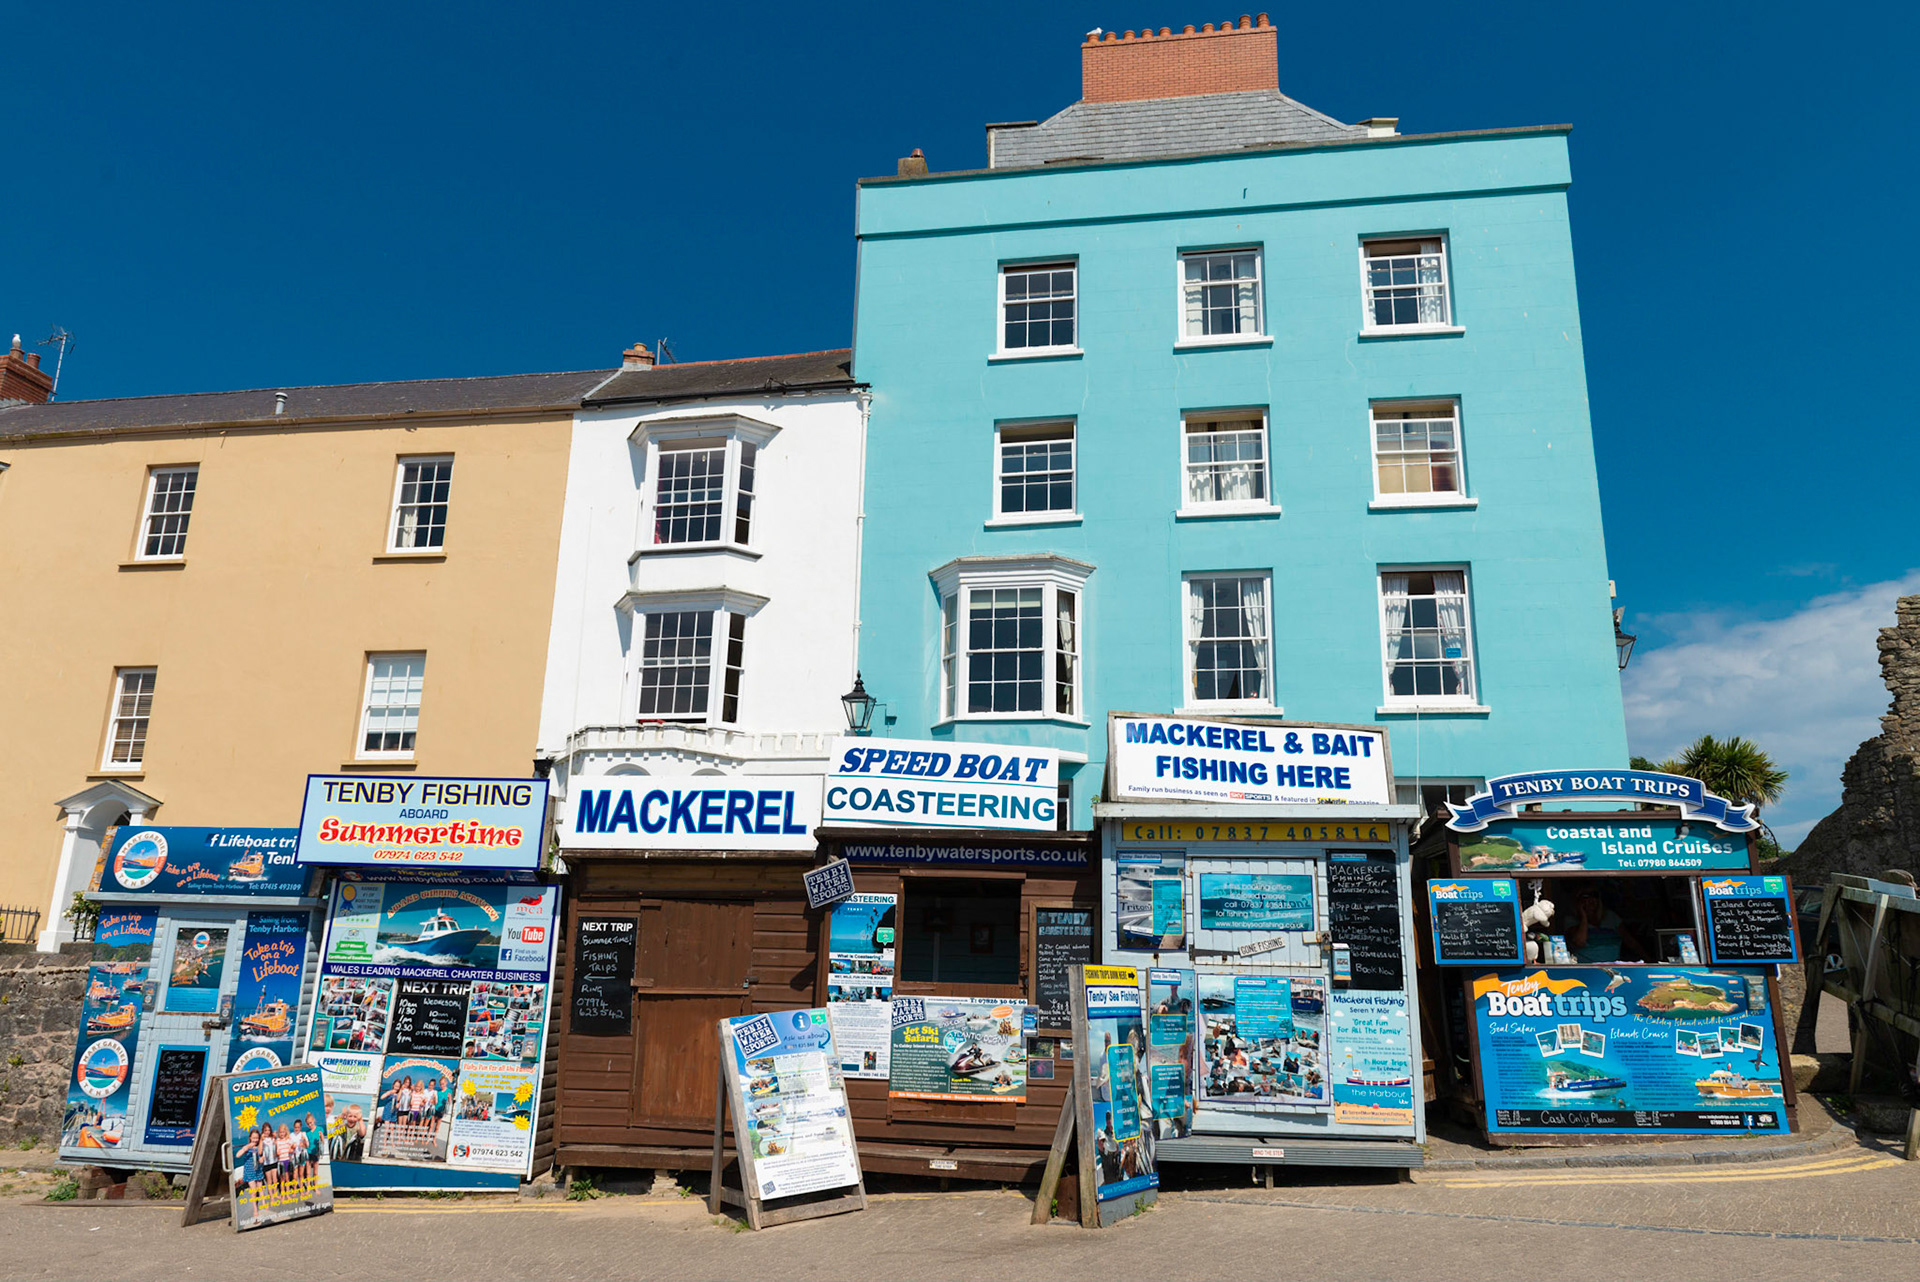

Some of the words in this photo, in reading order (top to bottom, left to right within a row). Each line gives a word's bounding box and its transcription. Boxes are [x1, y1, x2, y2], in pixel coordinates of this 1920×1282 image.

[1126, 722, 1275, 753] MACKEREL
[1283, 732, 1304, 755] &
[1311, 733, 1375, 758] BAIT
[839, 747, 952, 777] SPEED
[953, 753, 1049, 782] BOAT
[1155, 755, 1268, 785] FISHING
[1276, 764, 1351, 790] HERE
[322, 781, 416, 804] TENBY
[421, 783, 532, 806] FISHING
[1499, 777, 1564, 797] TENBY
[1570, 776, 1626, 791] BOAT
[1630, 777, 1690, 797] TRIPS
[1128, 785, 1150, 793] Family
[1164, 787, 1193, 795] business
[1280, 795, 1309, 804] featured
[826, 786, 1056, 822] COASTEERING
[399, 808, 448, 820] ABOARD
[575, 789, 808, 835] MACKEREL
[319, 818, 522, 847] Summertime
[1134, 825, 1182, 840] Call:
[1195, 826, 1268, 840] 07837
[1286, 826, 1378, 841] 405816
[1546, 825, 1615, 839] Coastal
[1619, 825, 1652, 839] and
[121, 834, 144, 855] MARY
[144, 833, 166, 856] GABRIEL
[219, 834, 275, 848] Lifeboat
[1601, 840, 1658, 855] Island
[1662, 840, 1733, 854] Cruises
[374, 850, 411, 861] 07974
[414, 851, 436, 861] 623
[439, 852, 463, 862] 542
[845, 843, 1088, 863] www.tenbywatersports.co.uk
[164, 862, 180, 876] Take
[187, 862, 201, 873] trip
[1328, 865, 1391, 876] MACKEREL
[1617, 858, 1636, 868] Tel:
[1637, 858, 1667, 868] 07980
[1668, 858, 1703, 868] 864509
[117, 872, 155, 888] TENBY
[176, 877, 186, 888] on
[192, 870, 221, 882] Lifeboat
[367, 874, 506, 885] www.tenbyfishing.co.uk
[807, 864, 846, 886] TENBY
[1332, 874, 1374, 882] FISHING
[259, 883, 278, 891] 07415
[278, 883, 302, 891] 493109
[810, 874, 849, 895] WATER
[1708, 886, 1734, 896] Boat
[1734, 886, 1762, 896] trips
[812, 882, 851, 904] SPORTS
[1435, 890, 1459, 899] Boat
[1459, 890, 1484, 901] trips
[1713, 900, 1745, 909] Island
[1747, 900, 1775, 908] Cruise
[100, 914, 120, 929] Take
[121, 914, 127, 922] a
[128, 912, 142, 925] trip
[259, 915, 280, 925] Sailing
[280, 915, 298, 924] from
[1048, 912, 1089, 925] TENBY
[101, 932, 113, 940] on
[120, 922, 153, 937] Lifeboat
[248, 924, 271, 935] Tenby
[272, 925, 306, 933] Harbour
[582, 922, 609, 932] NEXT
[610, 923, 634, 932] TRIP
[243, 942, 270, 961] Take
[270, 943, 278, 951] a
[278, 939, 296, 957] trip
[1240, 942, 1258, 955] GONE
[1257, 937, 1283, 951] FISHING
[260, 952, 273, 962] on
[514, 954, 546, 963] Facebook
[582, 950, 619, 963] FISHING
[252, 959, 300, 983] Lifeboat
[330, 965, 360, 974] WALES
[361, 966, 401, 976] LEADING
[401, 967, 450, 979] MACKEREL
[450, 969, 494, 980] CHARTER
[494, 971, 542, 981] BUSINESS
[1355, 962, 1378, 974] Book
[1378, 966, 1395, 976] Now
[402, 981, 439, 994] NEXT
[441, 983, 472, 996] TRIP
[1500, 975, 1541, 998] Tenby
[576, 997, 609, 1010] 07974
[892, 998, 922, 1009] TENBY
[1088, 990, 1107, 1004] Tenby
[1108, 990, 1120, 1002] Sea
[1120, 991, 1139, 1004] Fishing
[1333, 995, 1373, 1005] Mackerel
[1374, 996, 1405, 1008] Fishing
[892, 1005, 924, 1018] WATER
[1486, 991, 1553, 1016] Boat
[1554, 990, 1628, 1023] trips
[423, 1022, 440, 1031] RING
[892, 1014, 925, 1026] SPORTS
[1632, 1013, 1644, 1023] The
[1645, 1015, 1672, 1029] Caldey
[1674, 1016, 1697, 1028] Island
[736, 1018, 769, 1038] TENBY
[902, 1026, 921, 1036] Jet
[921, 1025, 939, 1035] Ski
[1489, 1021, 1509, 1035] Seal
[1509, 1022, 1537, 1035] Safari
[1610, 1027, 1639, 1040] Islands
[1641, 1027, 1669, 1040] Cruise
[739, 1027, 773, 1046] WATER
[744, 1034, 777, 1054] SPORTS
[904, 1034, 940, 1044] Safaris
[82, 1040, 102, 1064] MARY
[102, 1040, 127, 1064] GABRIEL
[83, 1082, 119, 1097] TENBY
[231, 1078, 270, 1093] 07974
[271, 1076, 294, 1088] 623
[295, 1072, 319, 1085] 542
[1351, 1088, 1367, 1097] the
[1368, 1089, 1407, 1098] Harbour
[1540, 1109, 1567, 1125] Cash
[1568, 1112, 1591, 1128] Only
[1590, 1111, 1618, 1125] Please
[472, 1147, 494, 1155] 07974
[495, 1149, 509, 1157] 623
